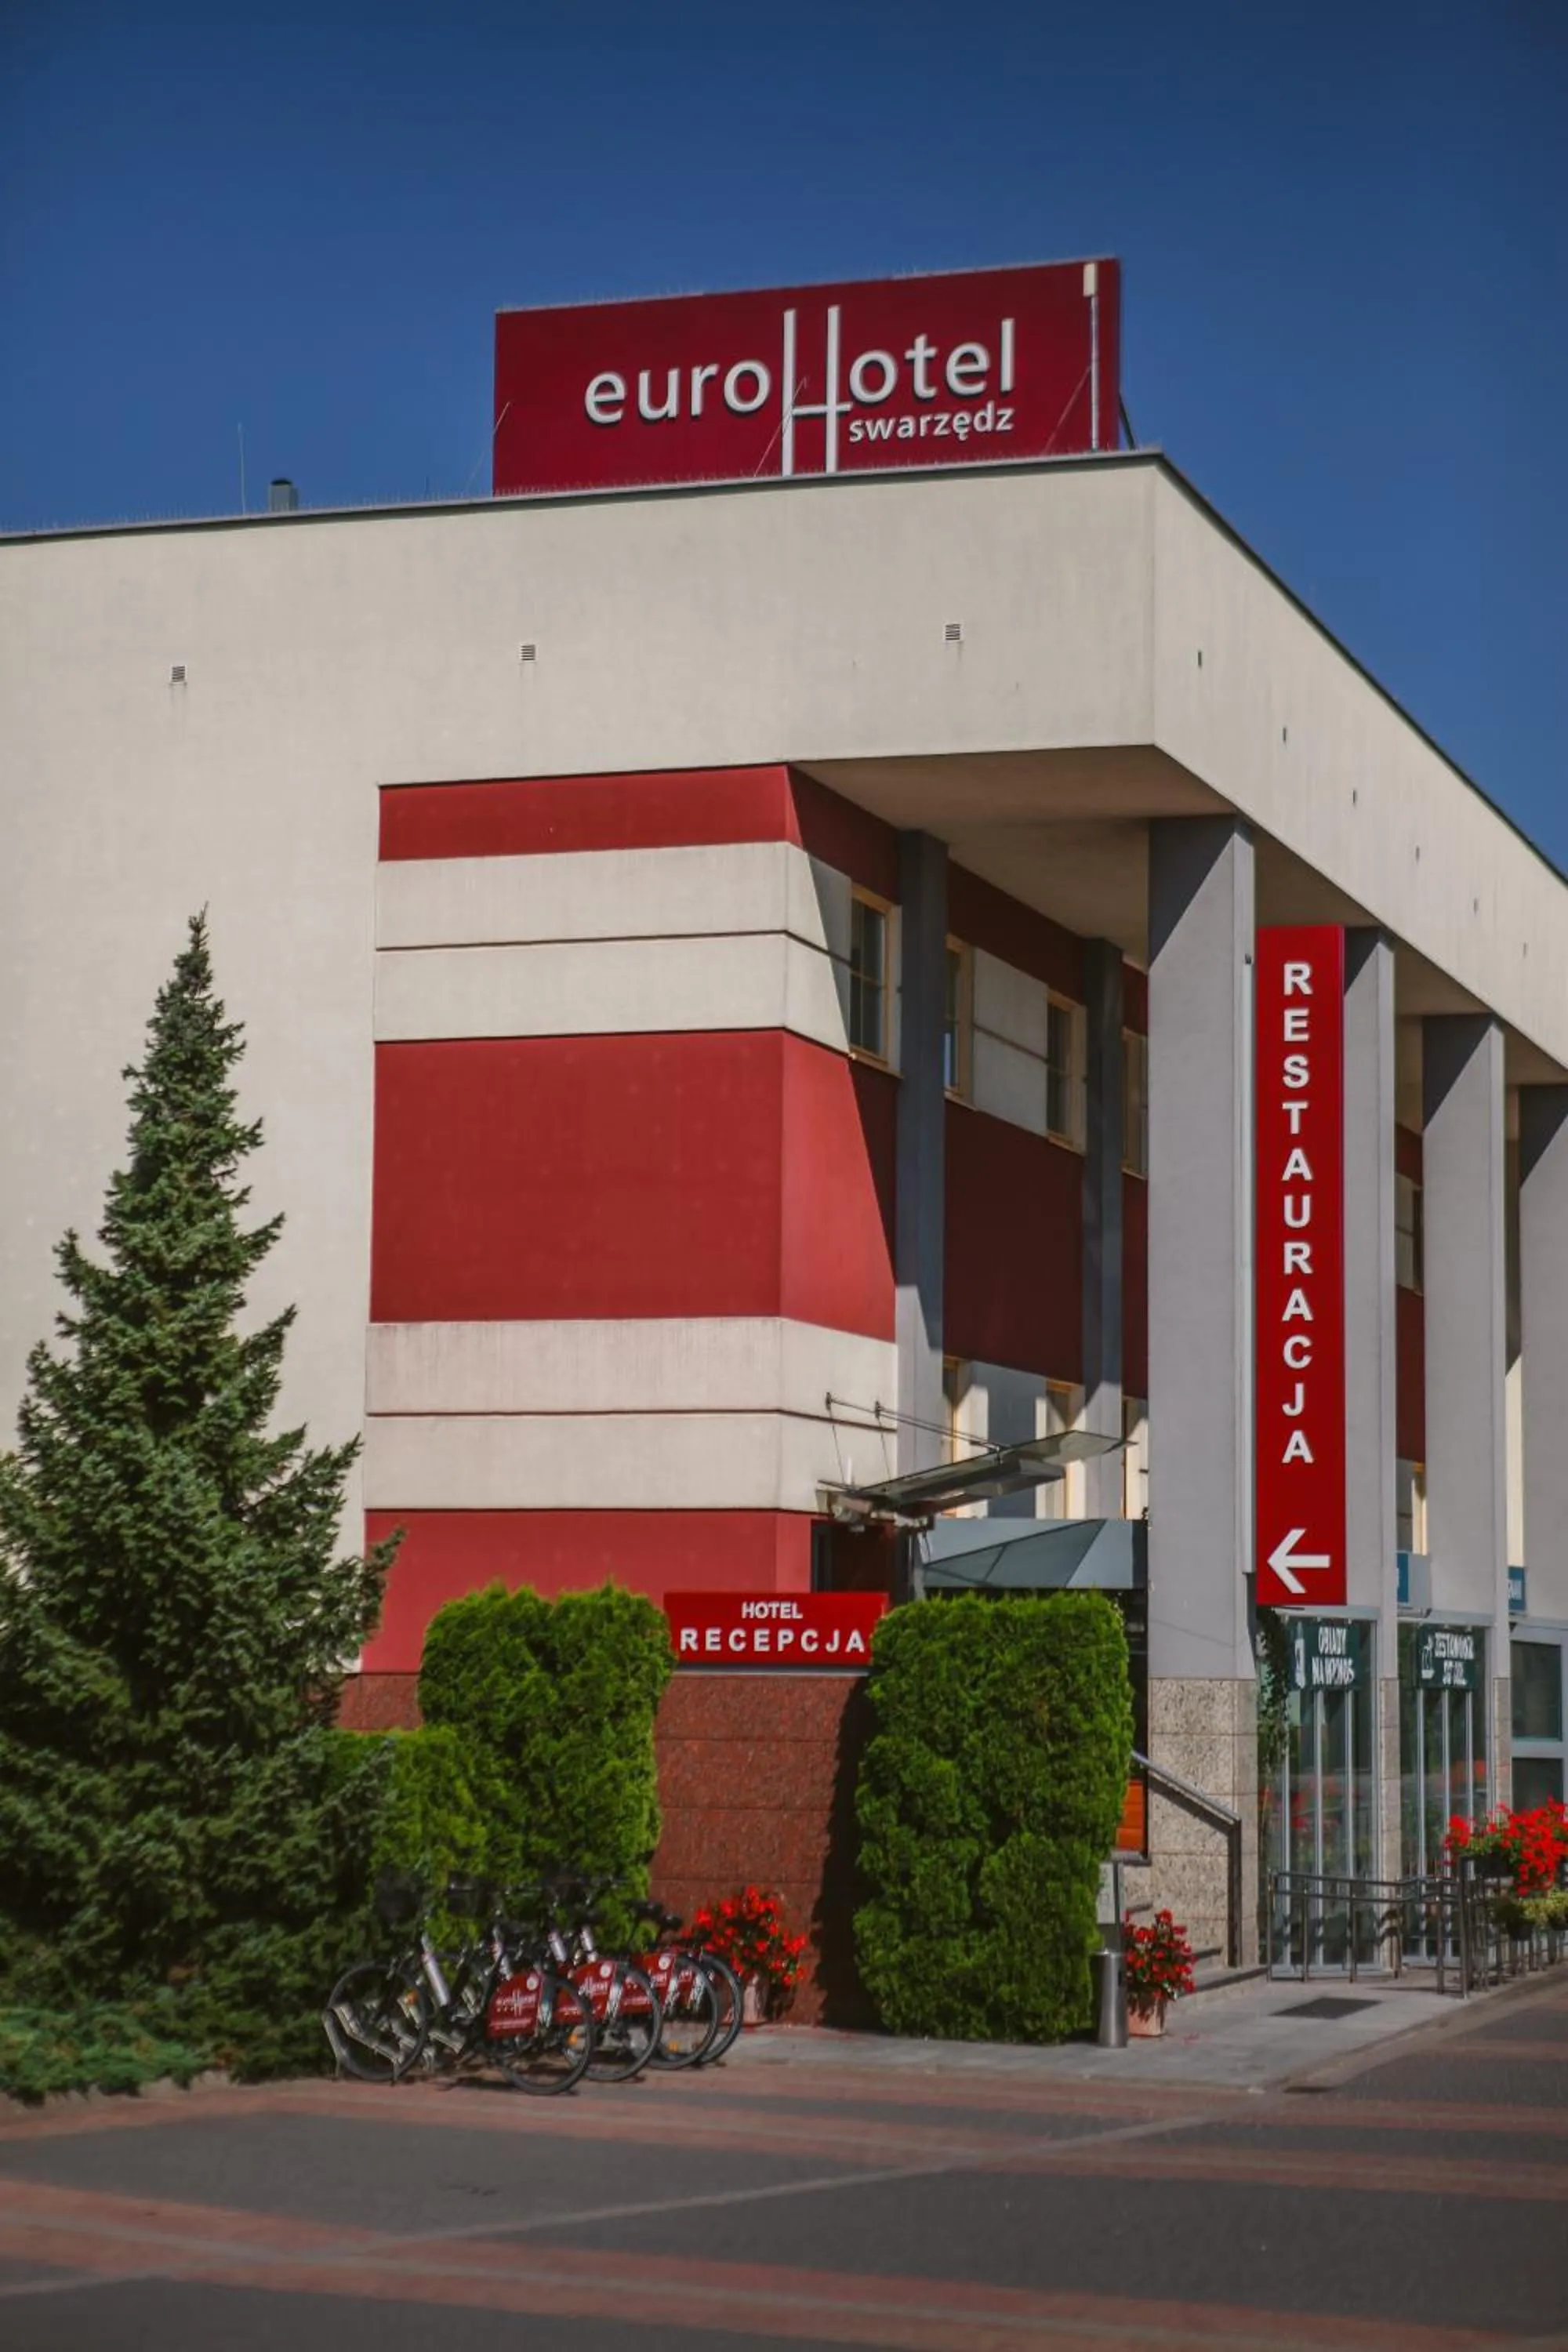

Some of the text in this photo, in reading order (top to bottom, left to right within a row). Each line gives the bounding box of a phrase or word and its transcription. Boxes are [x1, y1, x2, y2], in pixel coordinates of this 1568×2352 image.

[584, 305, 1014, 476] euroHotel
[848, 401, 1014, 443] swarzędz
[1281, 962, 1314, 1465] RESTAURACJA
[741, 1602, 804, 1619] HOTEL
[680, 1628, 866, 1653] RECEPCJA
